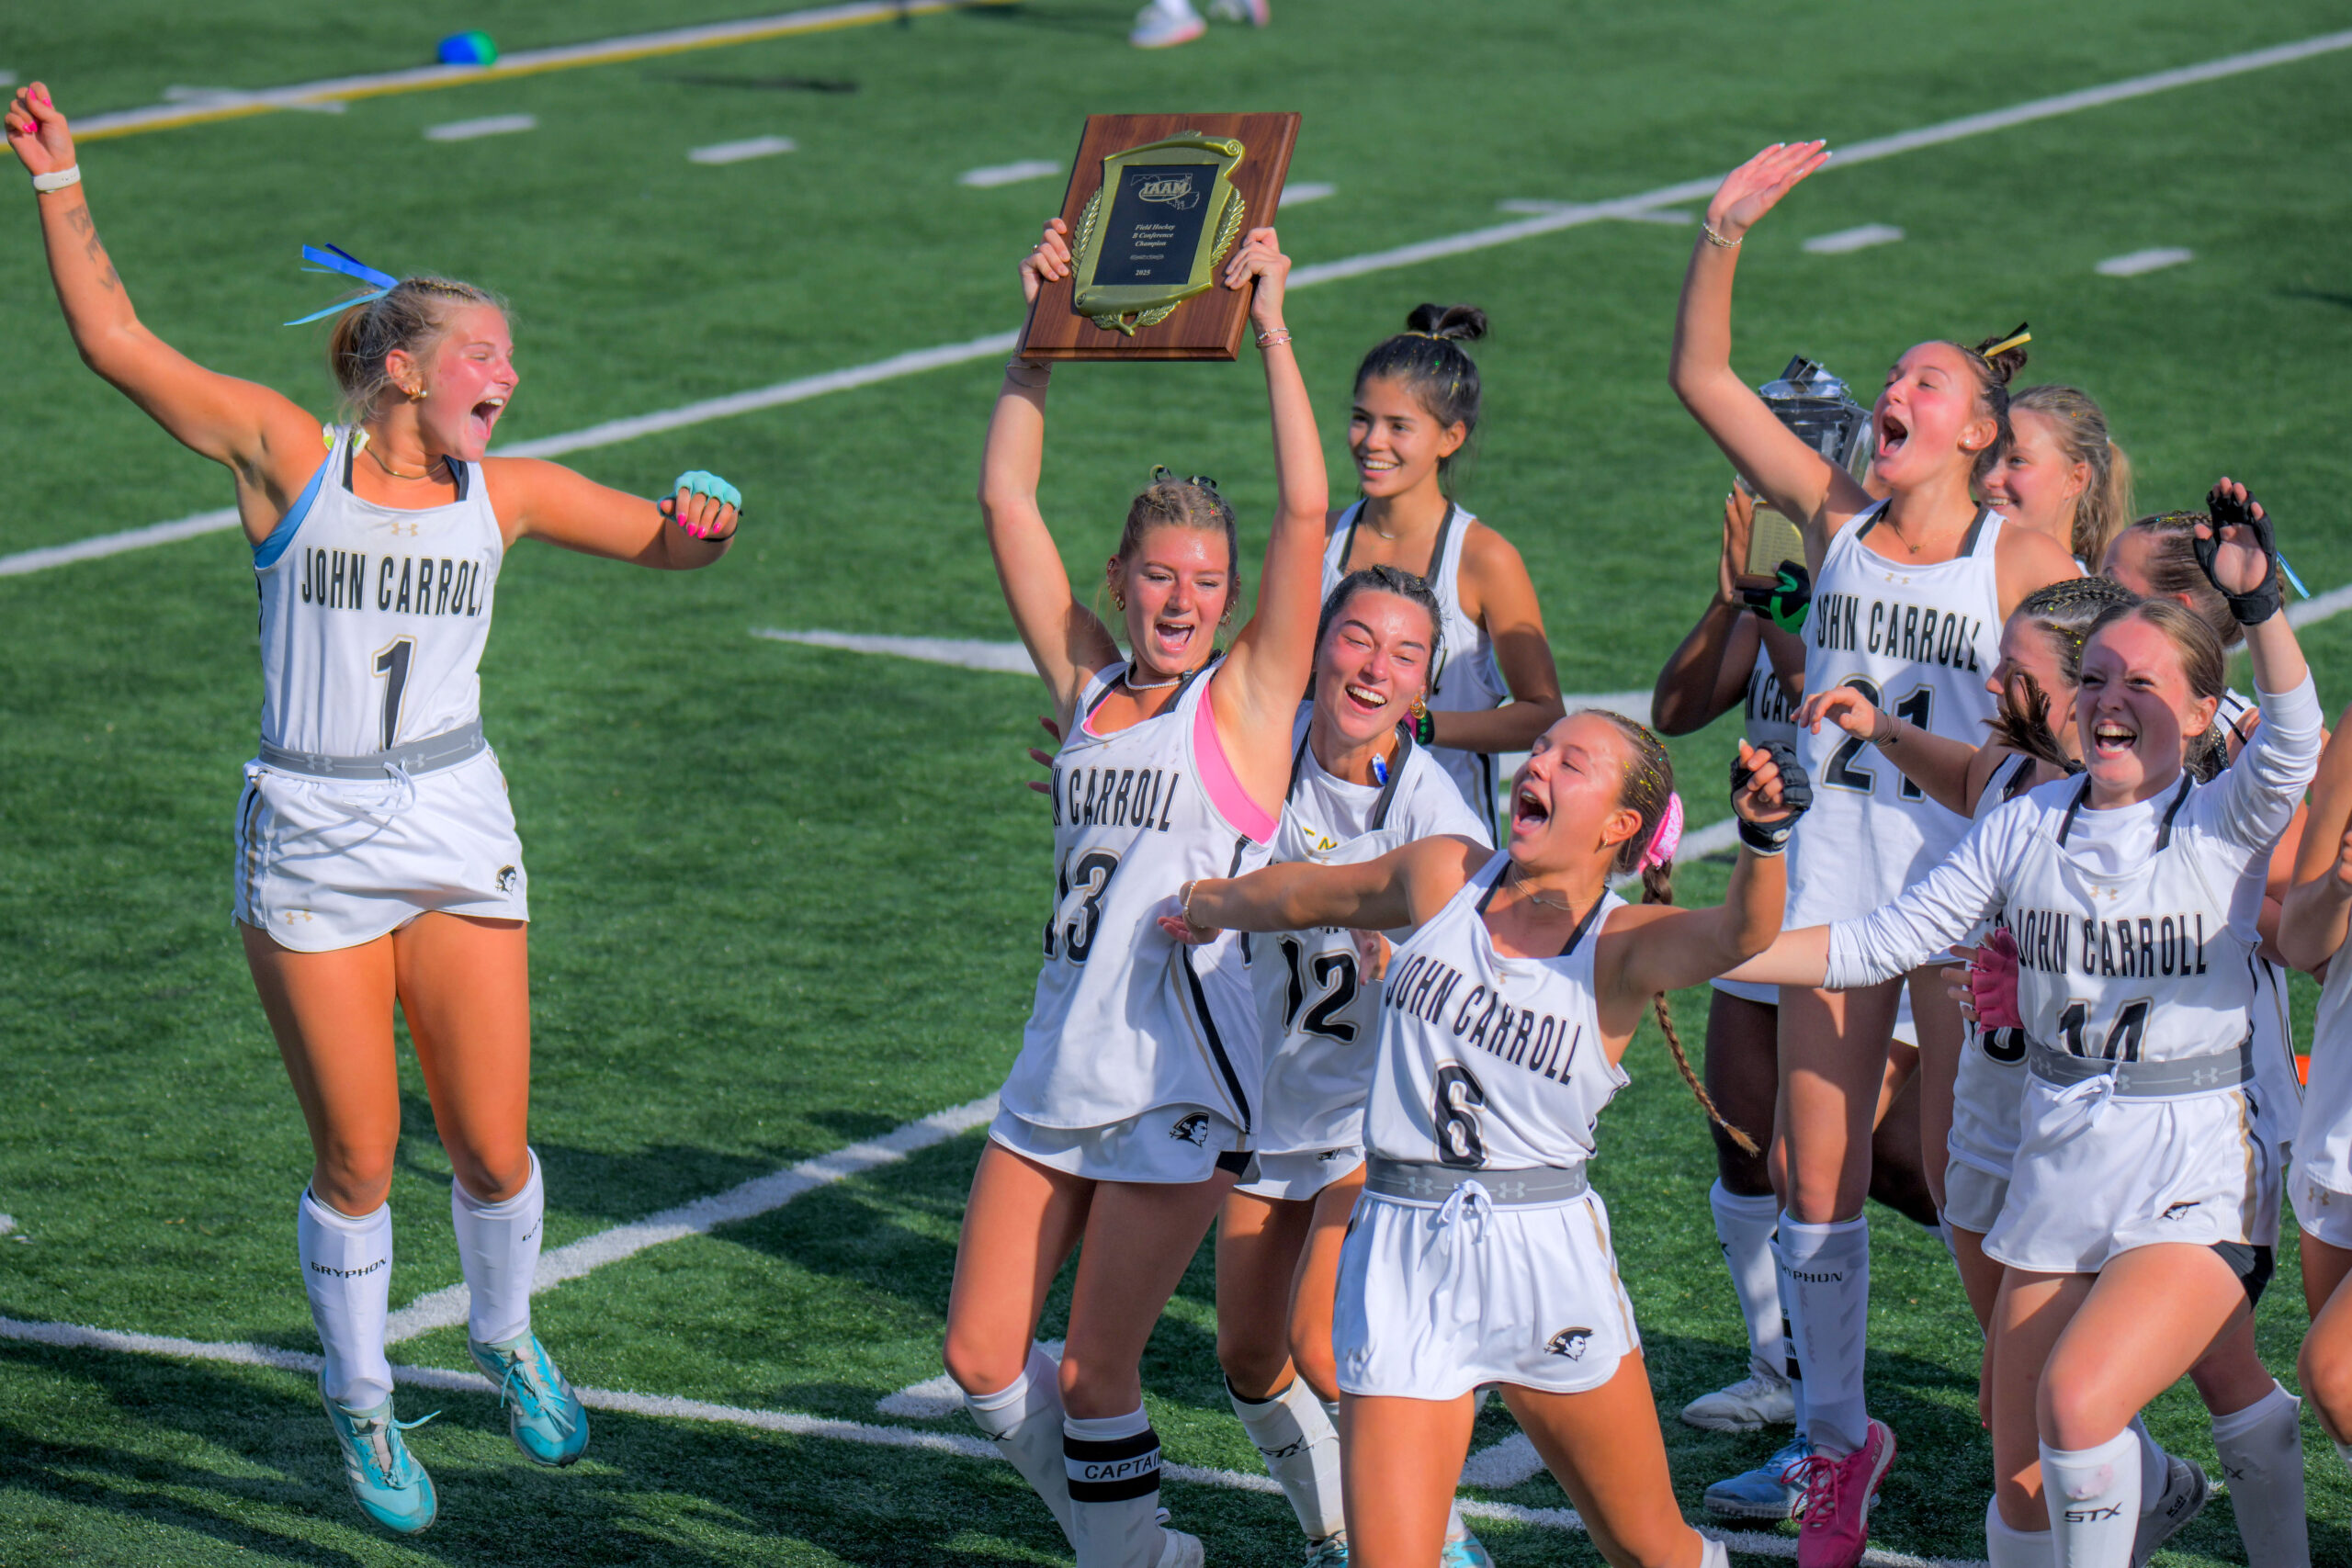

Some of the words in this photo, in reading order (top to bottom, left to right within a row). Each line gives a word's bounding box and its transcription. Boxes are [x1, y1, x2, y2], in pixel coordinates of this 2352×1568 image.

[1143, 182, 1189, 196] IAAM
[302, 546, 366, 611] JOHN
[377, 555, 487, 617] CARROL
[1817, 593, 1860, 652] JOHN
[1868, 600, 1982, 673] CARROLL
[373, 636, 416, 750] 1
[1069, 767, 1180, 832] CARROLL
[1043, 849, 1120, 964] 13
[2018, 908, 2070, 974] JOHN
[2082, 913, 2208, 978] CARROLL
[1279, 936, 1359, 1043] 12
[1385, 953, 1464, 1026] JOHN
[1452, 985, 1582, 1087] CARROLL
[2058, 998, 2154, 1062] 14
[1434, 1063, 1487, 1166] 6
[311, 1256, 387, 1279] GRYPHON
[2064, 1501, 2122, 1523] STX
